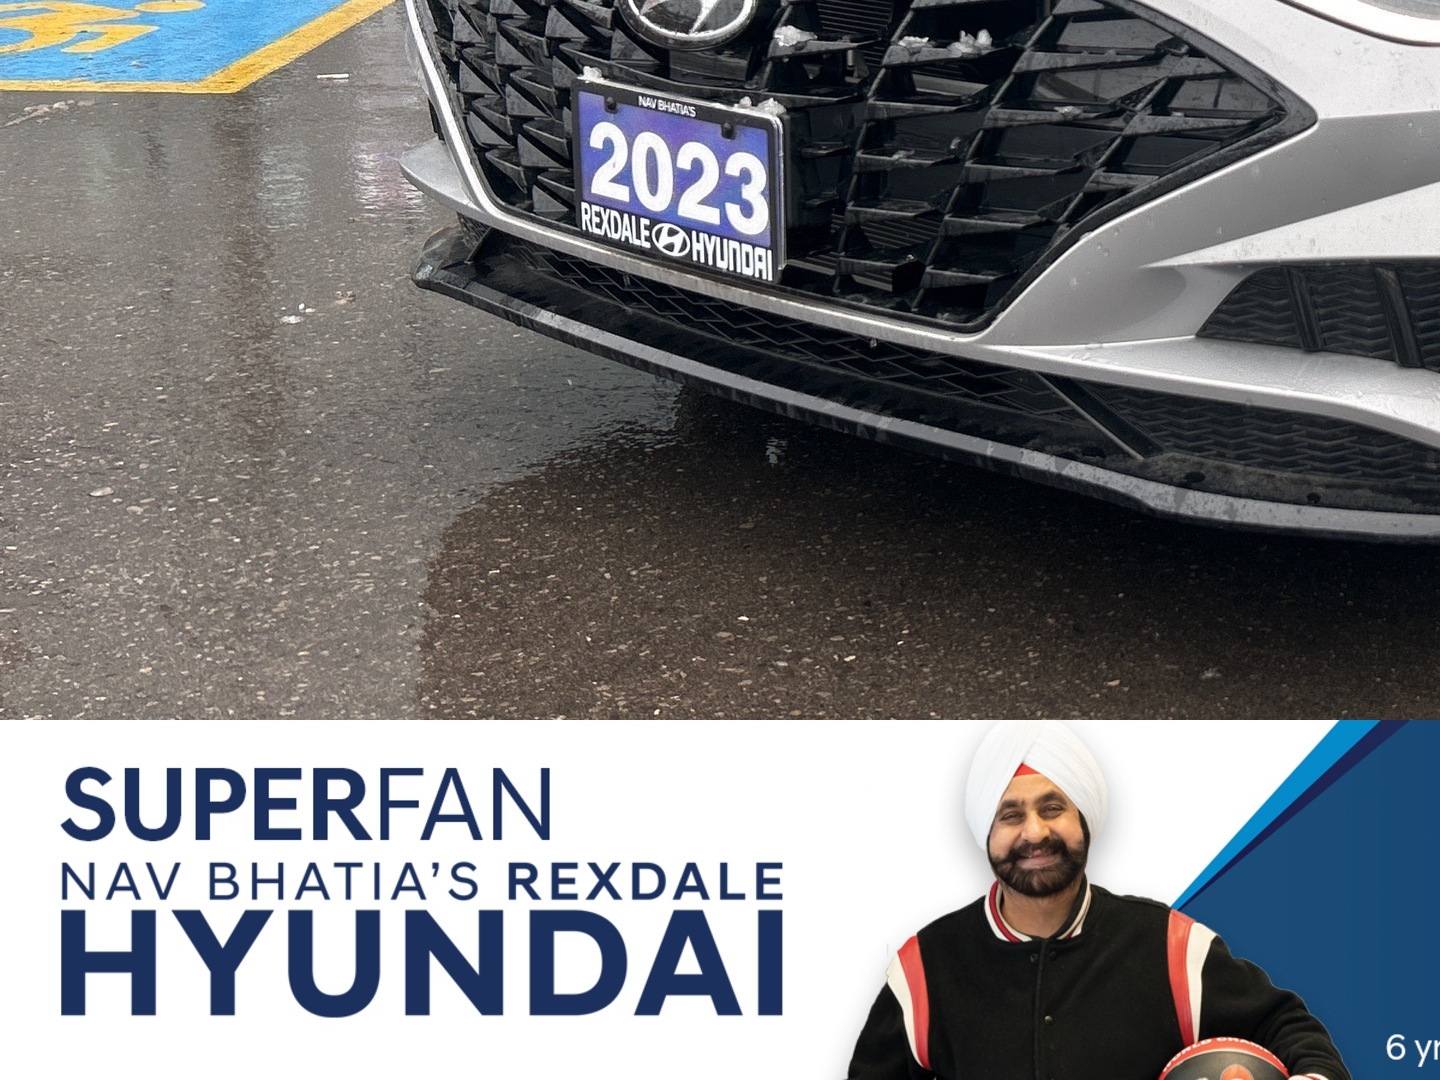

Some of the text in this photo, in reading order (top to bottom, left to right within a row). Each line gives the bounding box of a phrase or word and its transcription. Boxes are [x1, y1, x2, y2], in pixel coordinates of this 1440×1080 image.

[638, 95, 697, 118] NAV BHATIA'S
[589, 121, 770, 236] 2023
[580, 201, 774, 282] REXDALE HYUNDAI
